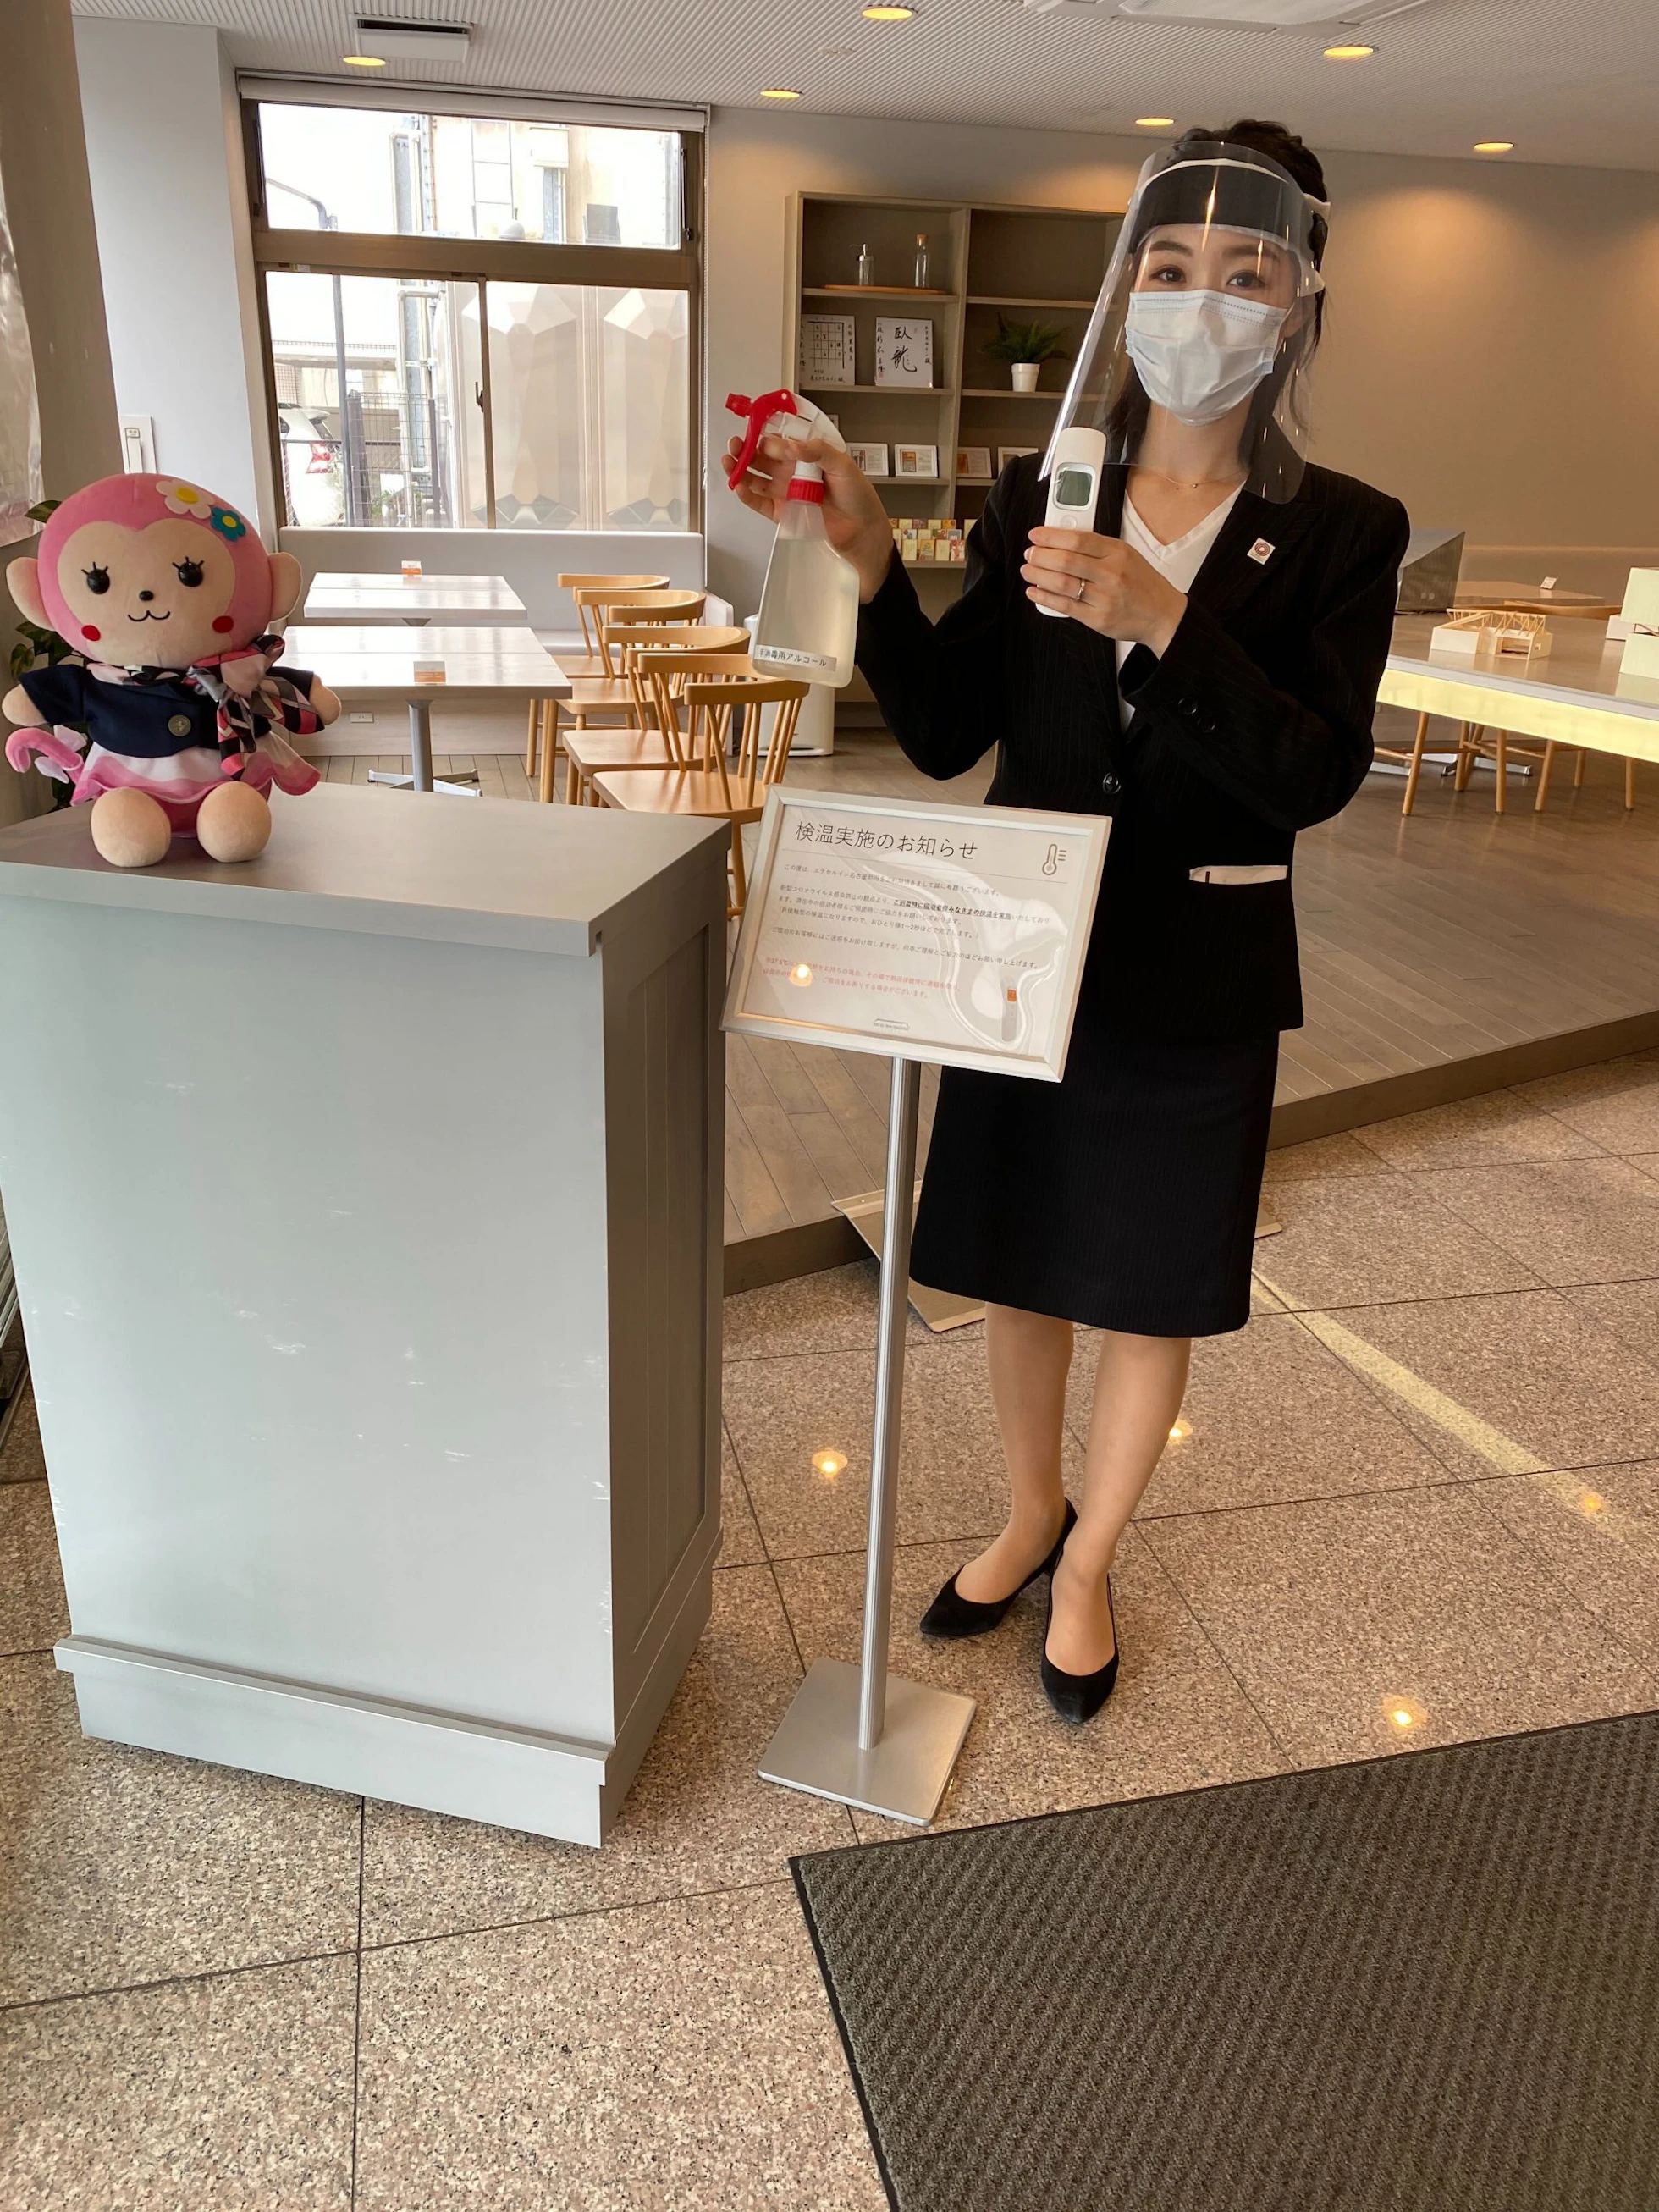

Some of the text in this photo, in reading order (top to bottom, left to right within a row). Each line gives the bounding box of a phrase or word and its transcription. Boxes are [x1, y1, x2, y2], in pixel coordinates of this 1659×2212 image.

[758, 648, 828, 667] 手消毒用アルコール
[794, 820, 978, 861] 検温実施のお知らせ
